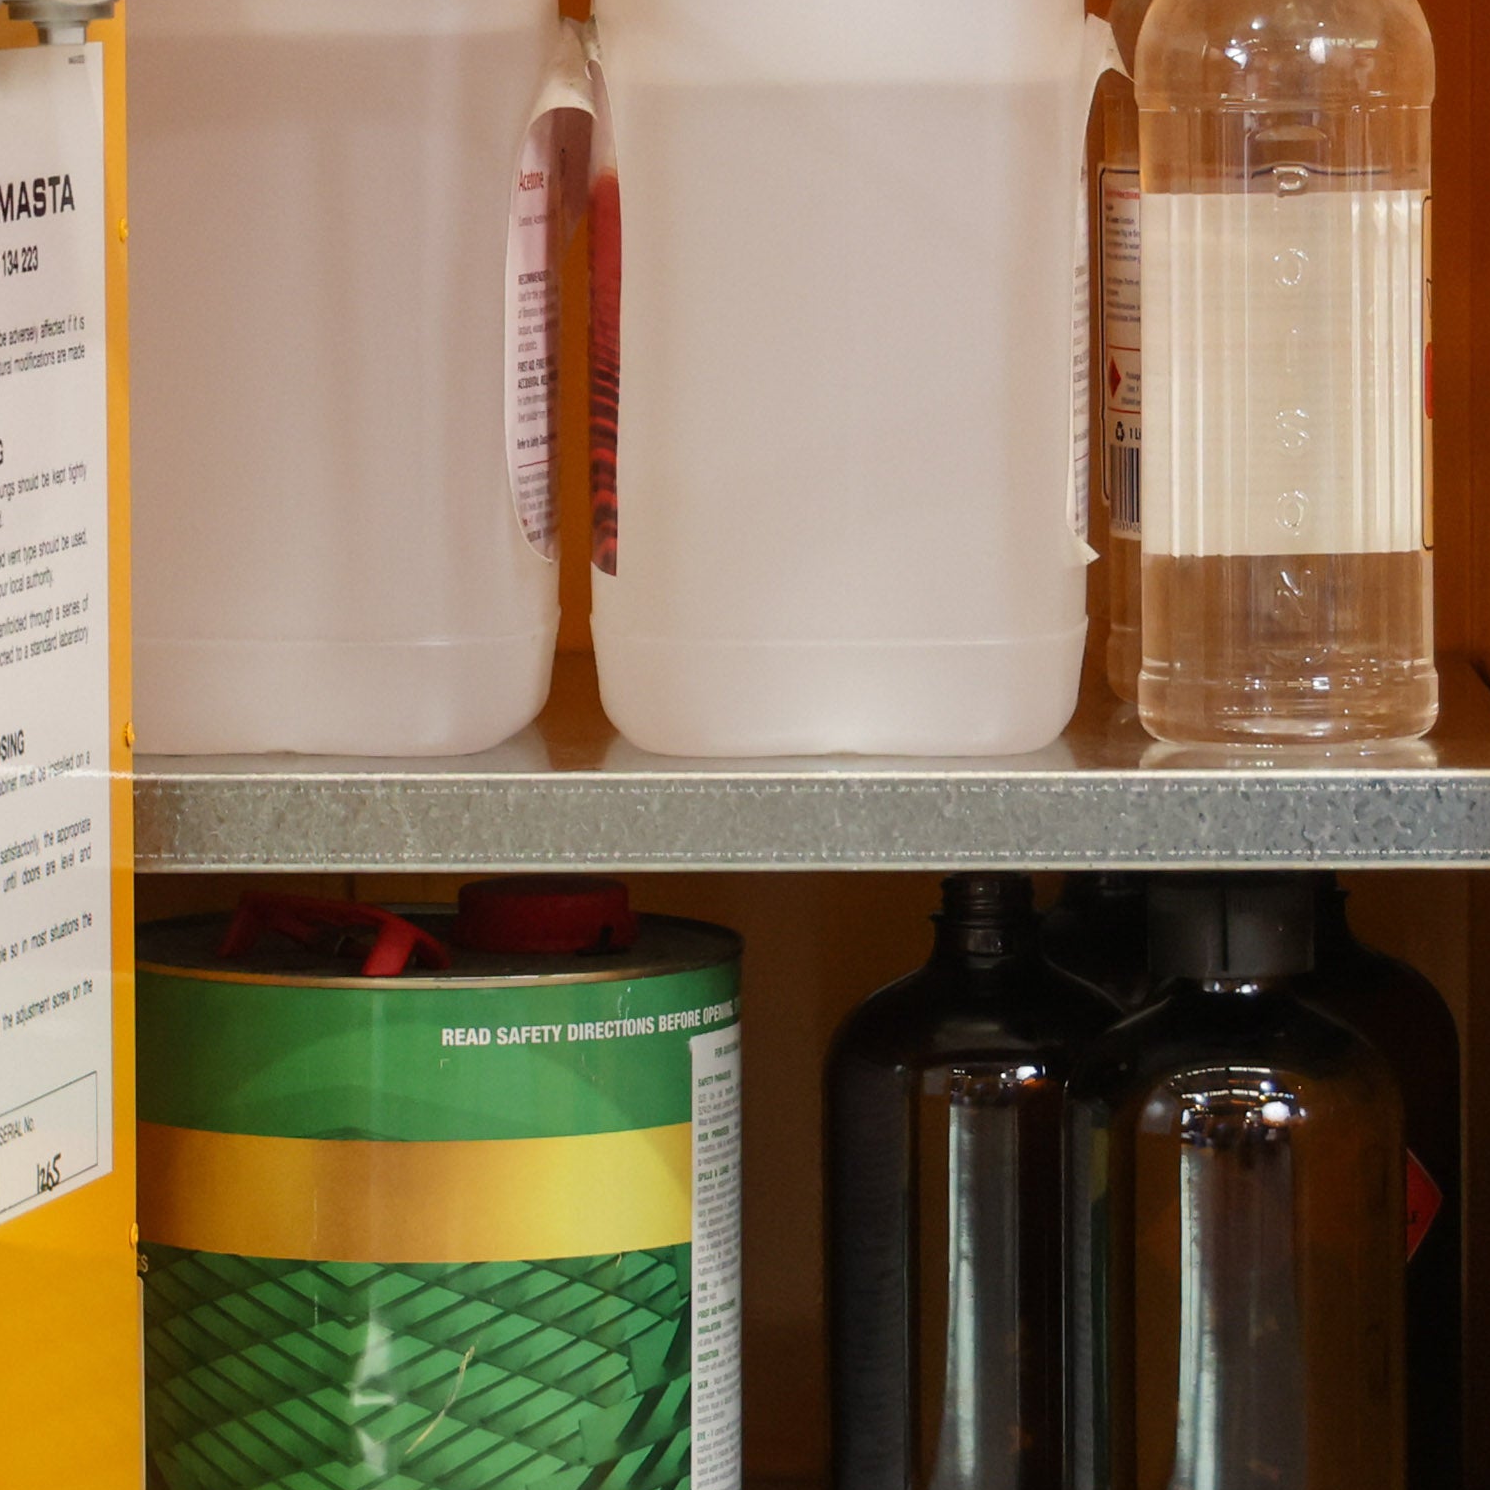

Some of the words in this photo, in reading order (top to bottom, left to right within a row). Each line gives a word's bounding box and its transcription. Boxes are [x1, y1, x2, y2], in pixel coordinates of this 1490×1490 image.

[518, 170, 544, 192] Acetone
[2, 249, 20, 276] 134
[21, 245, 39, 273] 223
[442, 1028, 491, 1046] READ
[497, 1024, 563, 1045] SAFETY
[567, 1016, 655, 1042] DIRECTIONS
[659, 1009, 701, 1032] BEFORE
